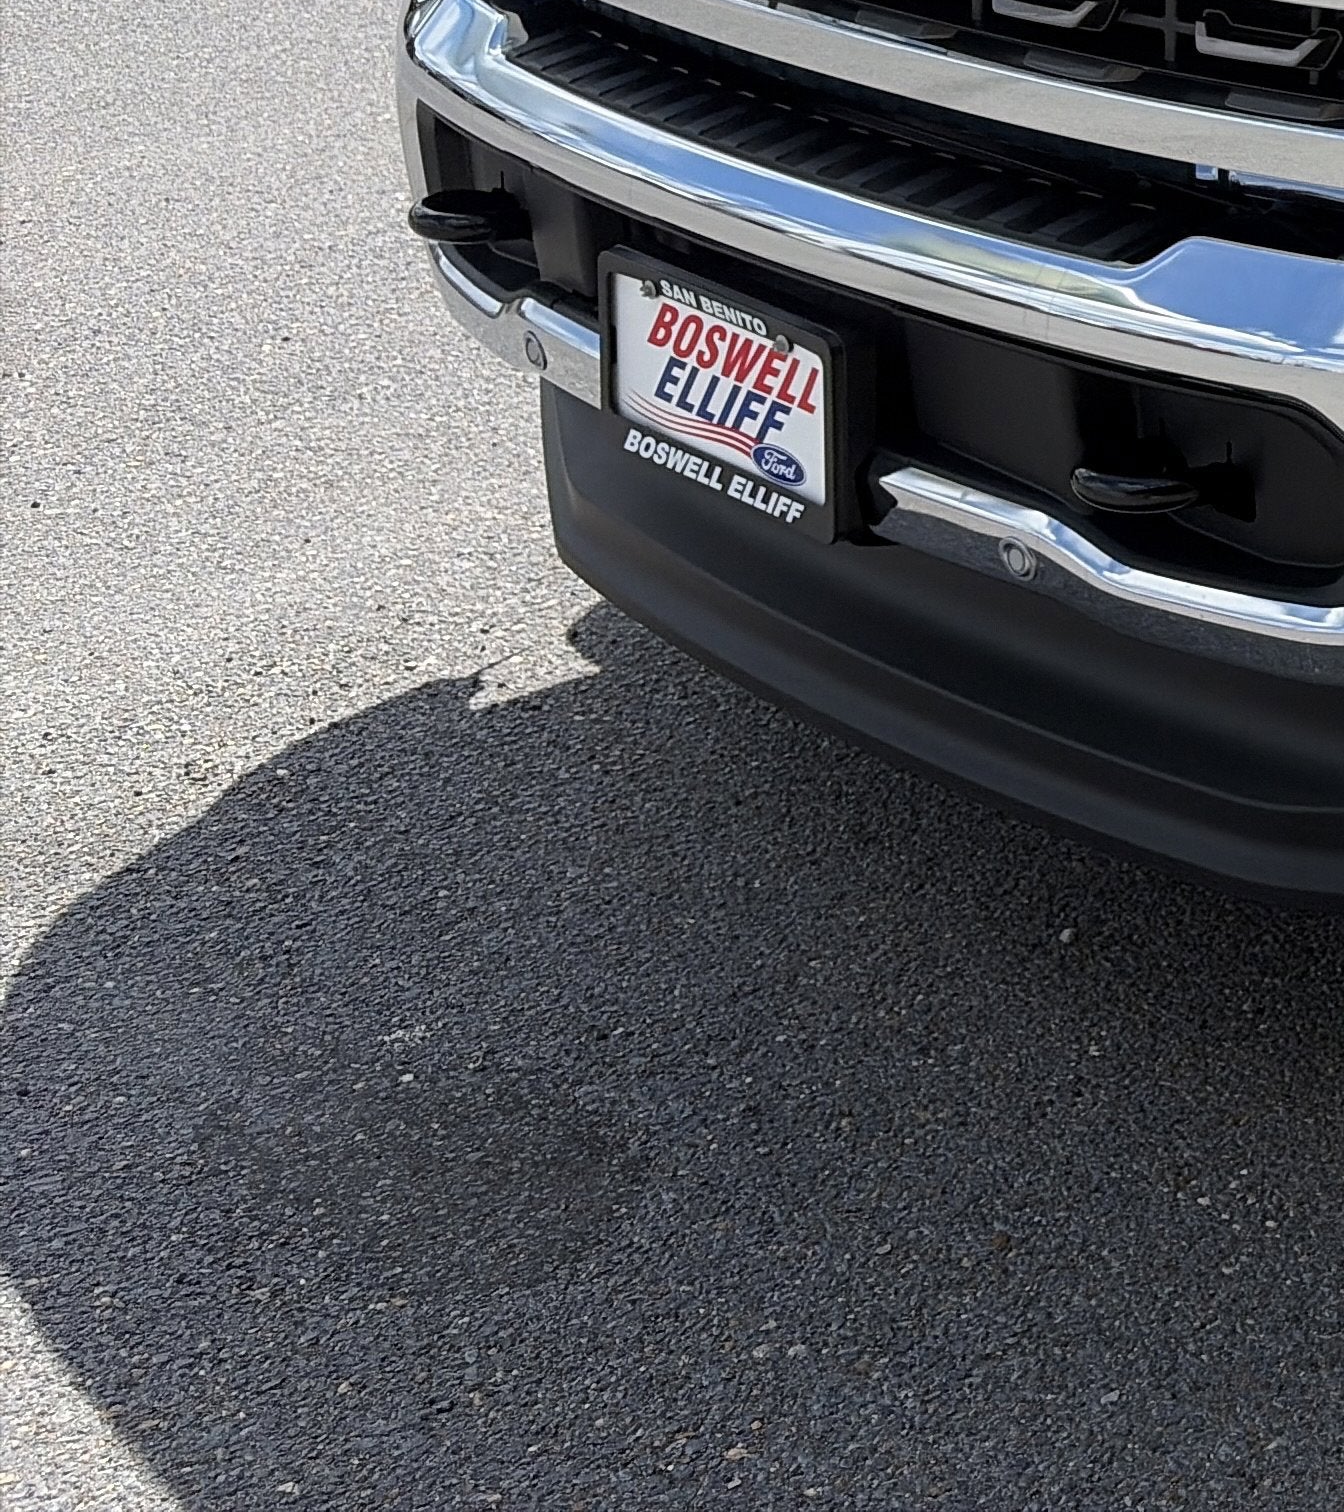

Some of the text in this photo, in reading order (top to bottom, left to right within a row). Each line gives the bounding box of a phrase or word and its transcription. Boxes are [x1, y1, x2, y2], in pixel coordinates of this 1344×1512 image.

[658, 279, 768, 336] SAN BENITO
[646, 302, 821, 415] BOSWELL
[653, 355, 793, 444] ELLIFF
[623, 428, 805, 524] BOSWELL ELLIFF
[760, 450, 798, 481] Ford
